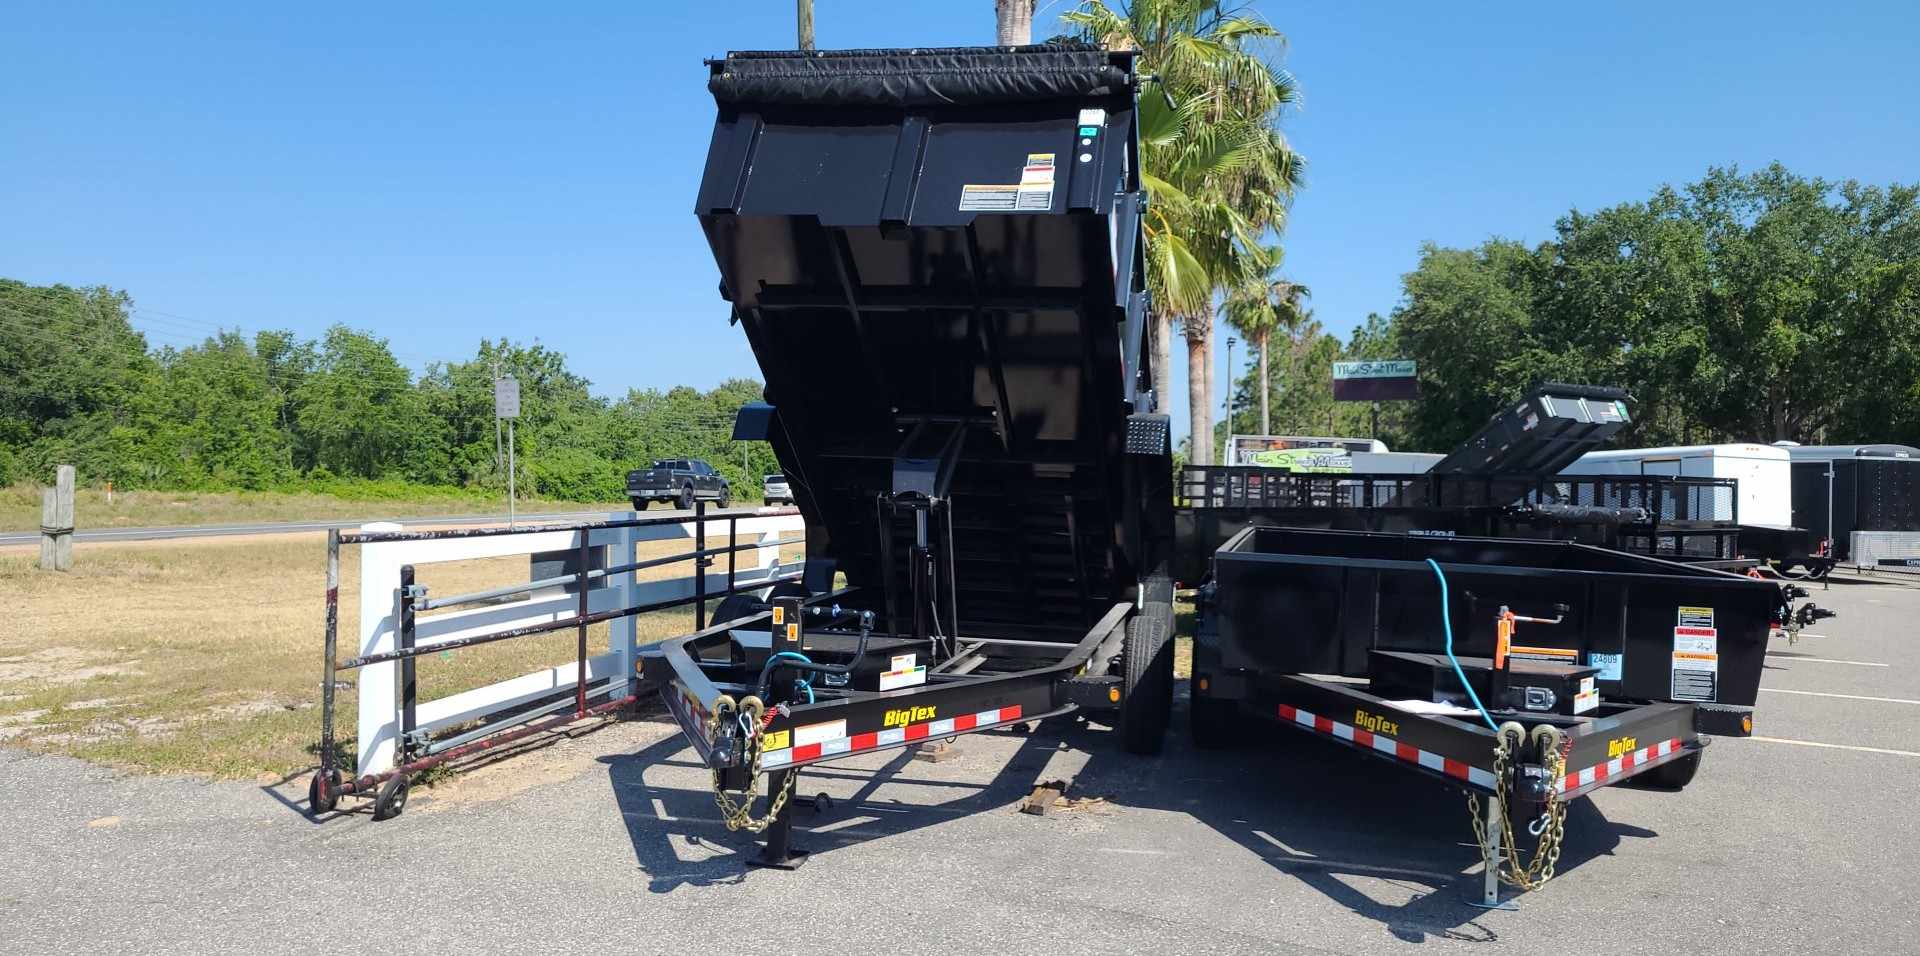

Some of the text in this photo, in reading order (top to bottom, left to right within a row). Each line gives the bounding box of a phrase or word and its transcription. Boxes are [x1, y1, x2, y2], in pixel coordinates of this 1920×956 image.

[883, 705, 937, 728] BigTex
[1354, 709, 1400, 736] BigTex
[1607, 736, 1637, 759] BigTex
